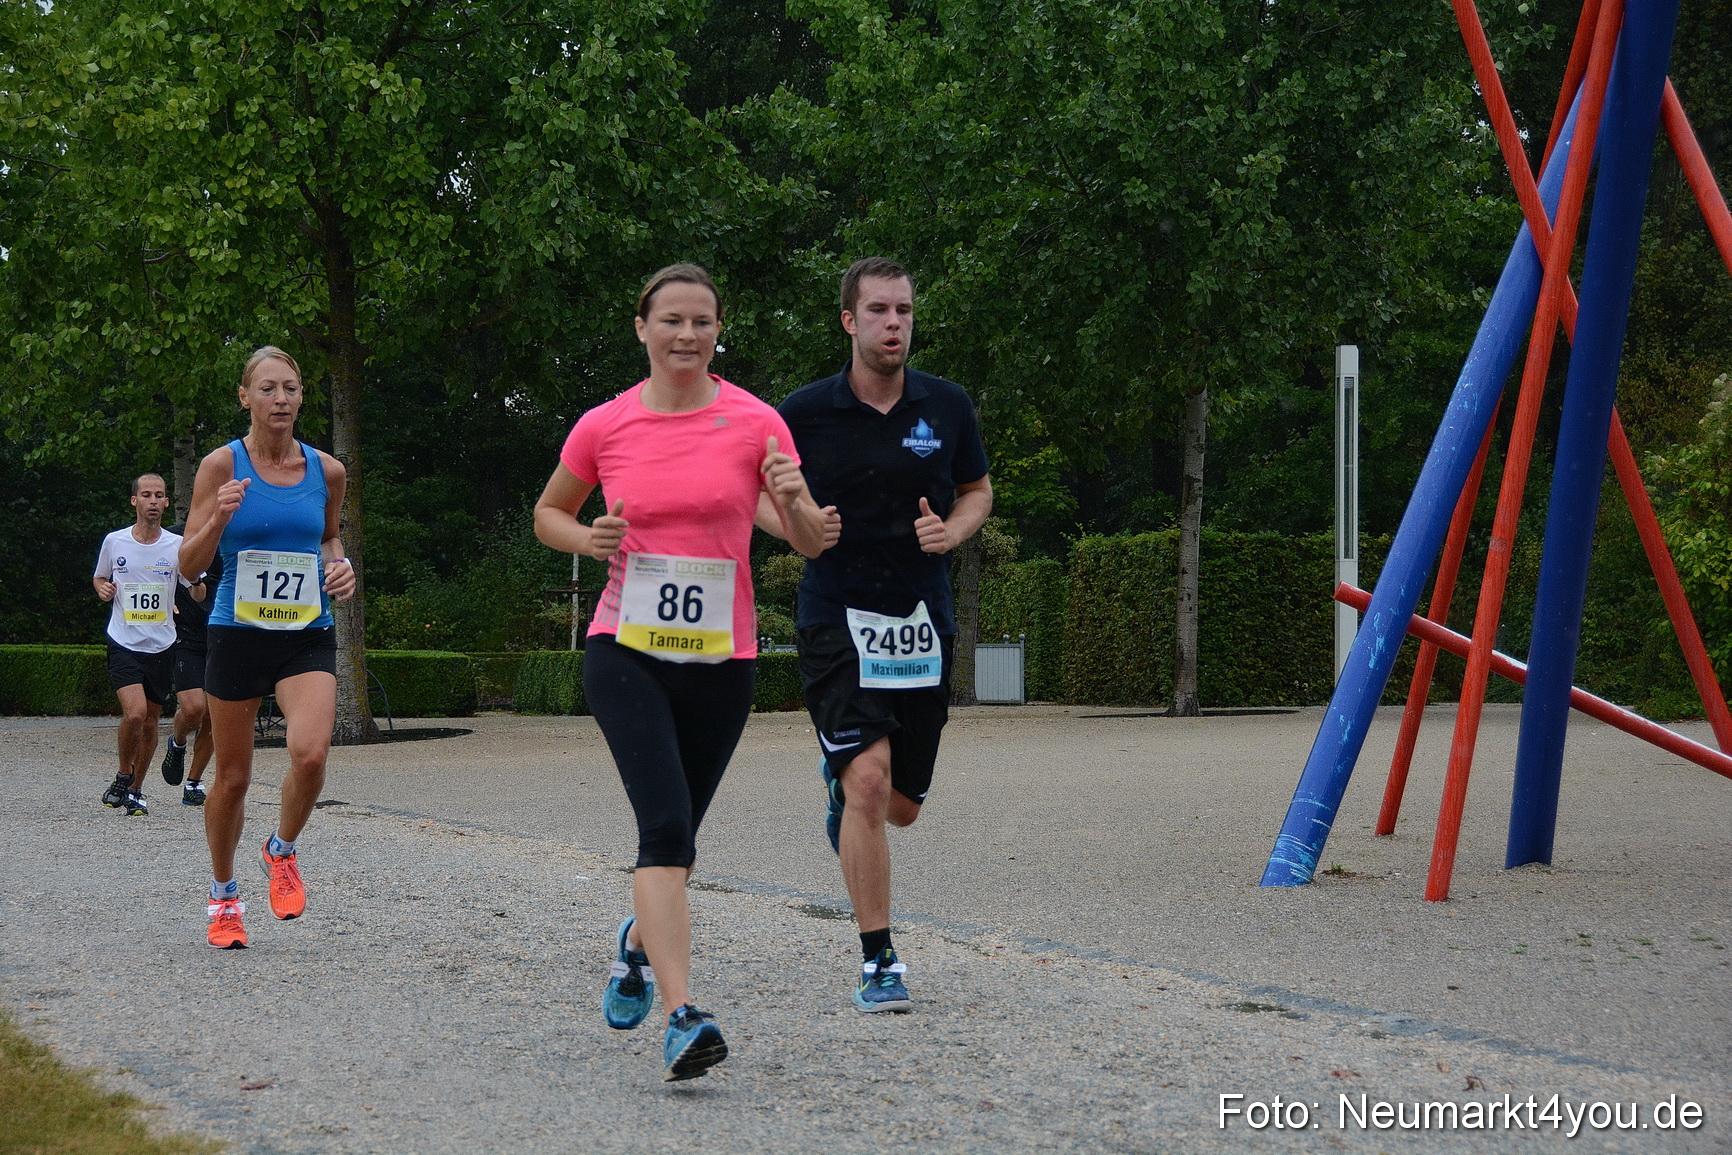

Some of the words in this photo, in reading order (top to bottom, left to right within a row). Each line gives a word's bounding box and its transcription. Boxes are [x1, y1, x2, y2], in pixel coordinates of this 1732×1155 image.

[278, 555, 312, 566] BOCK
[675, 561, 726, 576] BOCK
[256, 570, 304, 600] 127
[130, 593, 160, 610] 168
[658, 583, 704, 623] 86
[259, 606, 298, 620] Kathrin
[648, 632, 704, 650] Tamara
[860, 622, 933, 655] 2499
[872, 662, 930, 676] Maximilian
